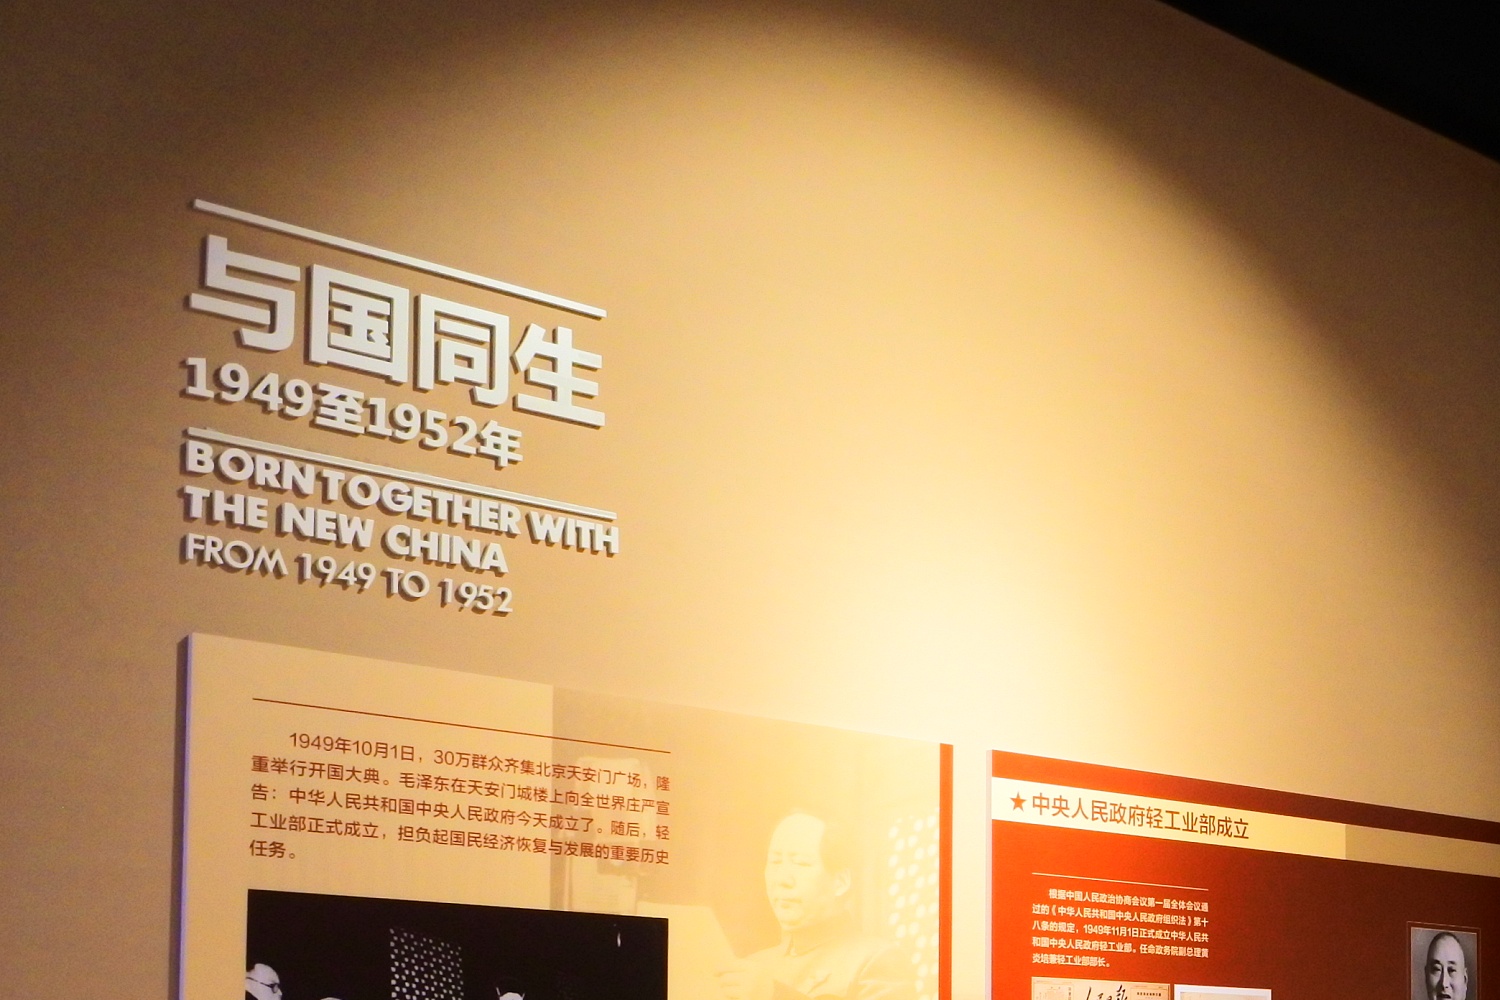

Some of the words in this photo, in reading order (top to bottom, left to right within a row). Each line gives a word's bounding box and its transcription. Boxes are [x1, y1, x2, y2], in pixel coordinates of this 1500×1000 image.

[189, 234, 606, 427] 与国同生
[185, 357, 523, 468] 1949至1952年
[183, 485, 269, 531] THE
[279, 502, 374, 549] NEW
[384, 524, 509, 574] CHINA
[187, 439, 315, 495] BORN
[322, 469, 521, 536] TOGETHER
[528, 511, 619, 555] WITH
[185, 533, 288, 578] FROM
[300, 552, 377, 590] 1949
[386, 567, 430, 599] TO
[442, 577, 514, 614] 1952
[1032, 792, 1250, 840] 中央人民政府轻工业部成立
